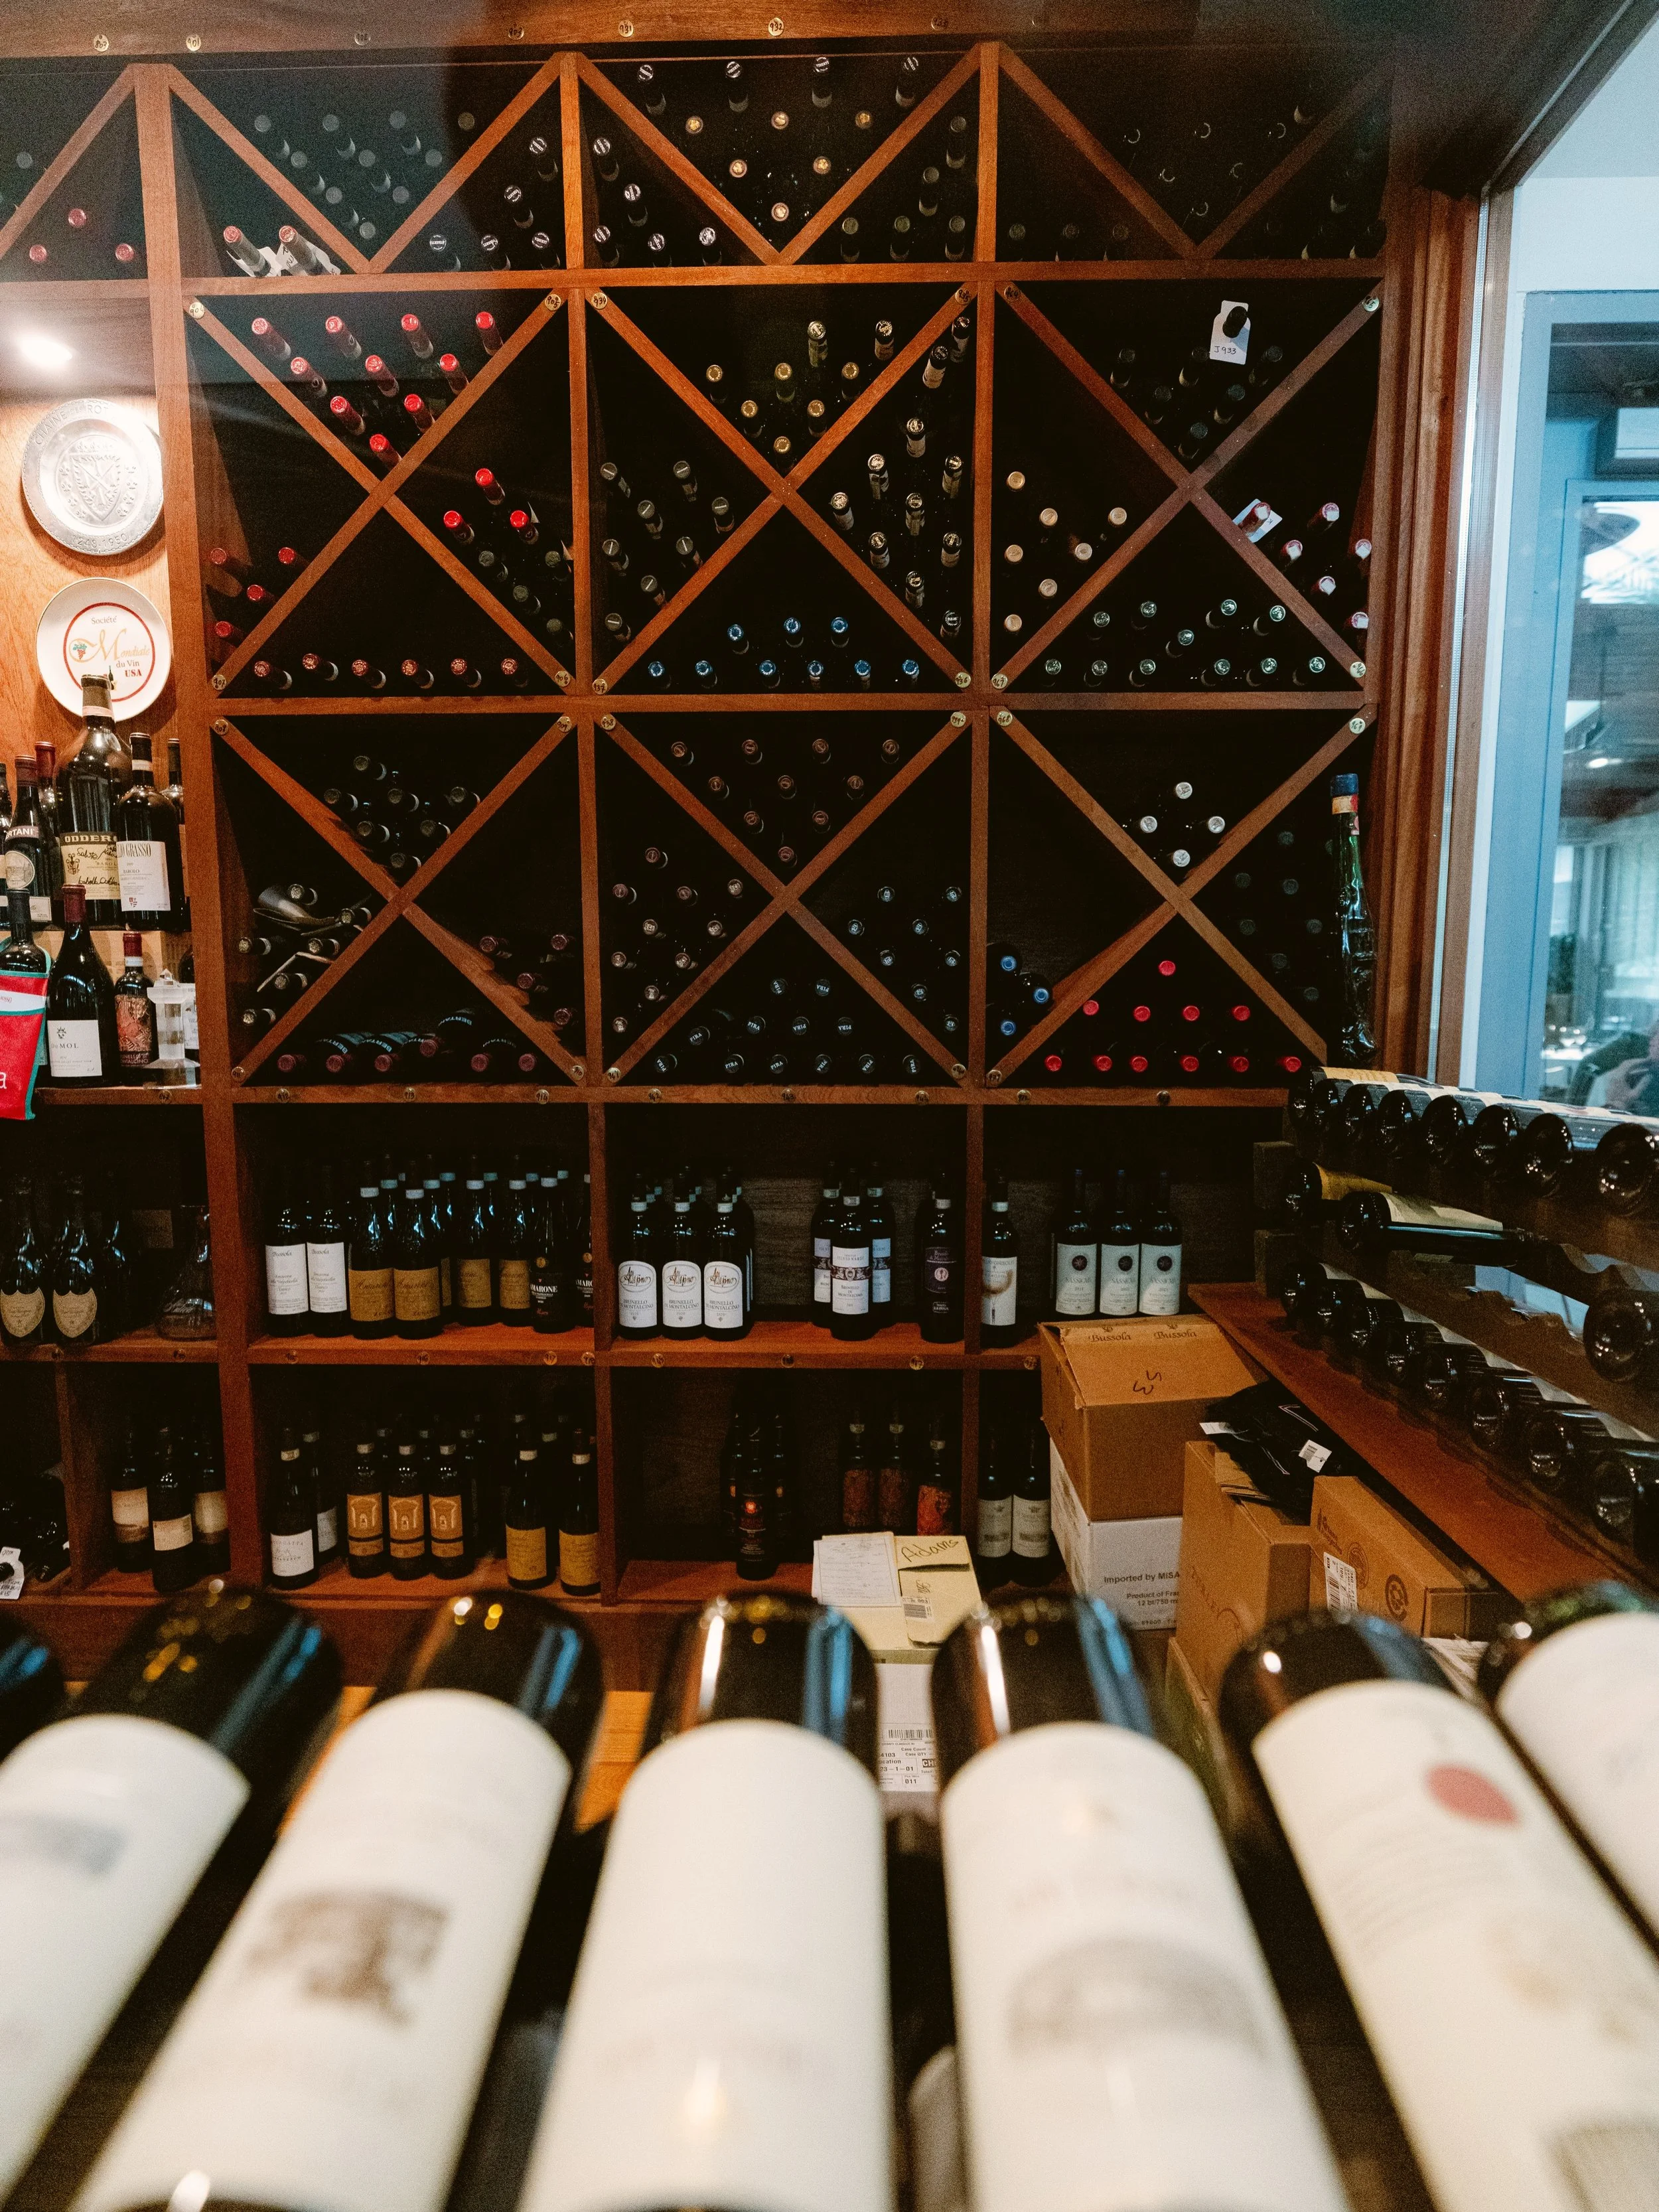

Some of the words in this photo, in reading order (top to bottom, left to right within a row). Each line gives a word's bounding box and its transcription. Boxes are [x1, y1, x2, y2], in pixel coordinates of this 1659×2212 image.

[619, 25, 632, 34] 931
[770, 23, 784, 32] 932
[188, 37, 200, 48] 901
[547, 295, 560, 309] 905
[91, 615, 117, 625] Société
[69, 628, 150, 662] Mondiale
[556, 674, 569, 683] 906
[956, 677, 968, 686] 936
[993, 678, 1005, 688] 967
[593, 683, 605, 693] 937
[126, 843, 151, 857] GRASSO
[748, 1021, 760, 1031] PIRA
[690, 1033, 702, 1042] PIRA
[657, 1059, 666, 1072] PIRA
[770, 1061, 783, 1070] PIRA
[817, 1059, 828, 1071] PIRA
[862, 1059, 873, 1070] PIRA
[1089, 1329, 1131, 1343] Bussola
[1154, 1328, 1198, 1340] Bussola
[1104, 1574, 1143, 1584] Imported
[1158, 1571, 1180, 1580] MISA
